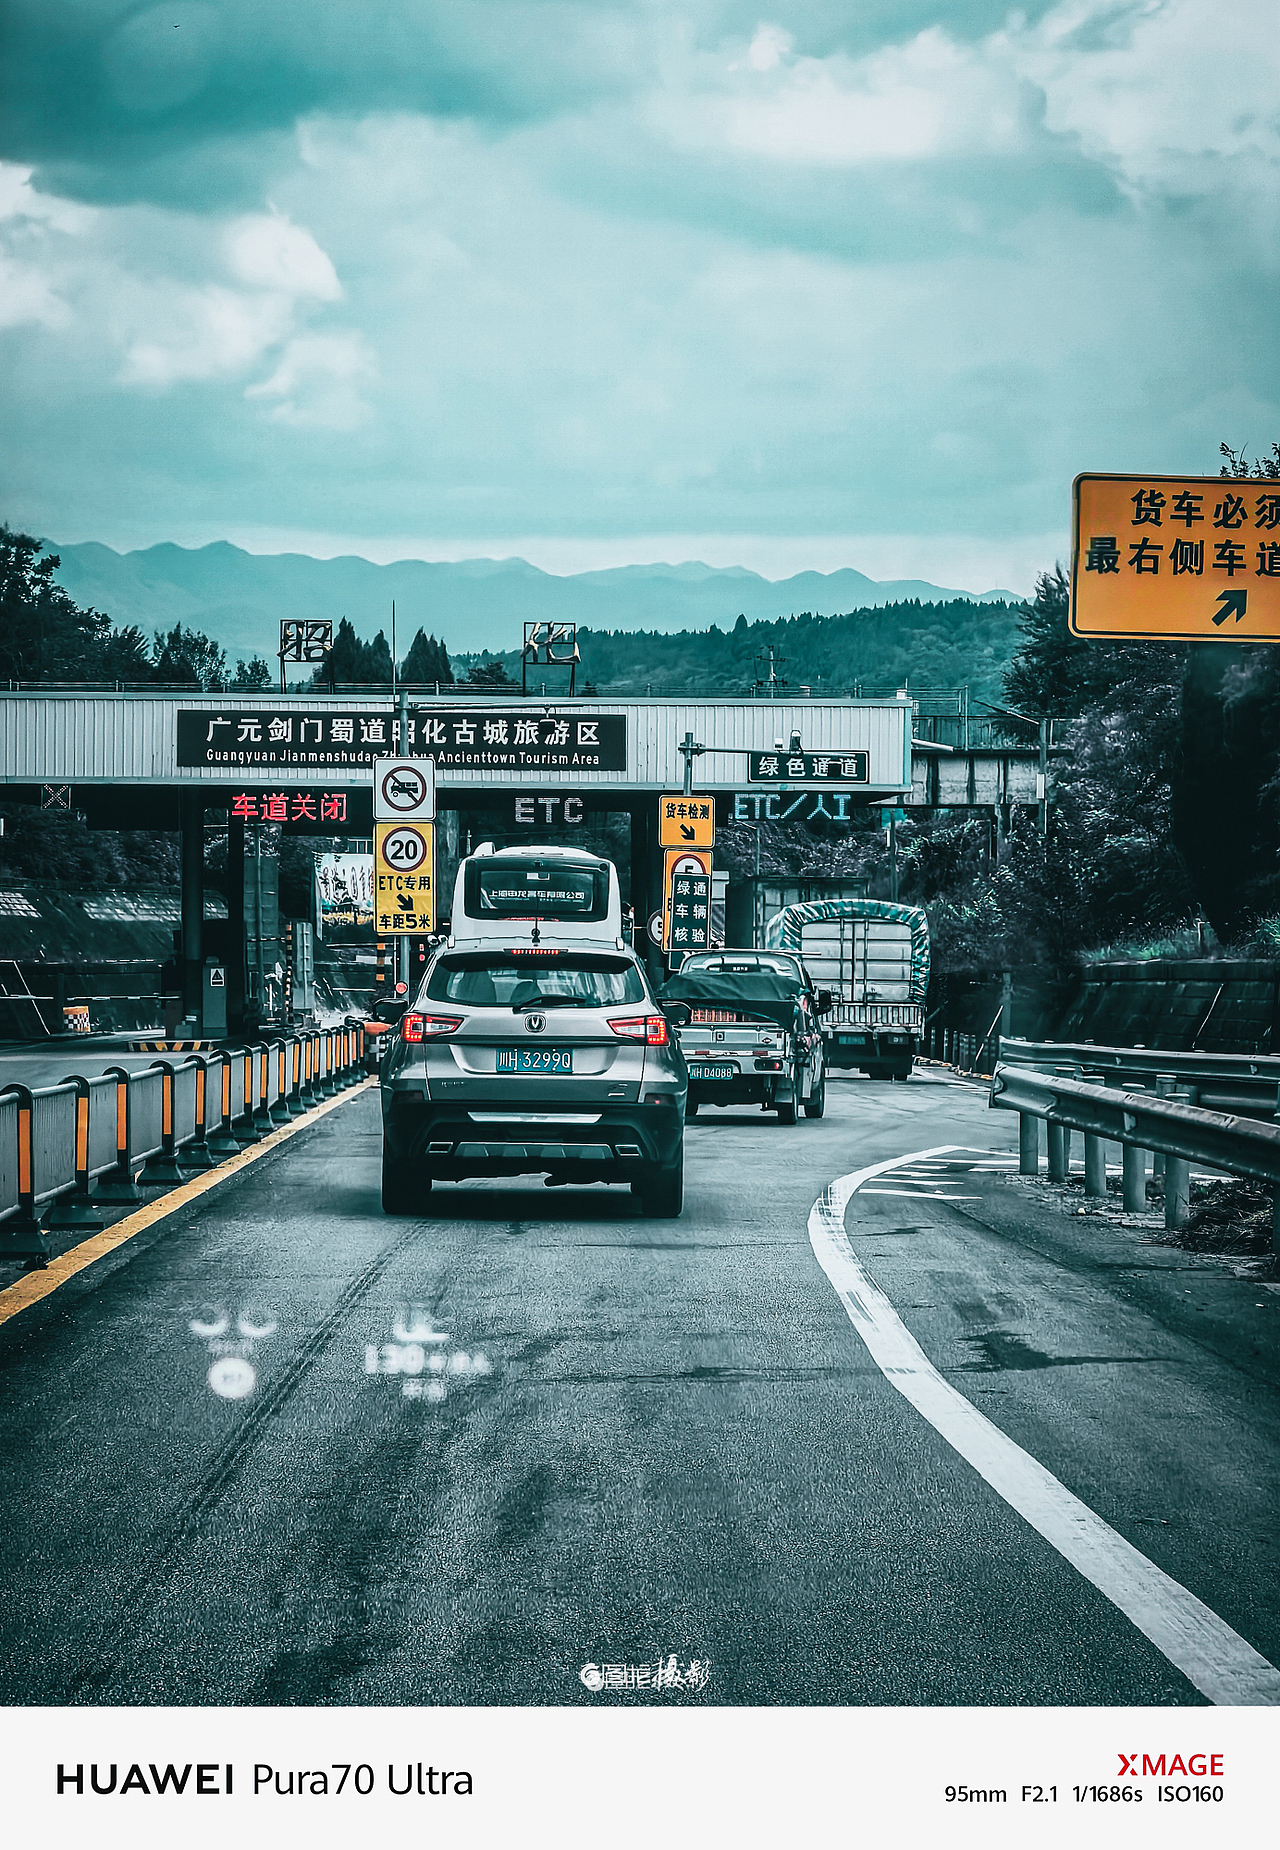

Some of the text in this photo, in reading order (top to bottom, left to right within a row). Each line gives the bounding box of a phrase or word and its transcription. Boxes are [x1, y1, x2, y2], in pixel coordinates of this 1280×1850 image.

[1130, 488, 1280, 530] 货车必须
[1085, 536, 1280, 577] 最右侧车道
[206, 716, 600, 746] 广元剑门蜀道昭化古城旅游区
[206, 748, 276, 764] Guangyuan
[438, 750, 516, 764] Ancienttown
[519, 751, 568, 765] Tourism
[572, 752, 600, 765] Area
[759, 756, 858, 777] 绿色通道
[232, 792, 347, 821] 车道关闭
[515, 797, 583, 823] ETC
[665, 803, 710, 820] 货车检测
[390, 839, 418, 860] 20
[378, 875, 431, 891] ETC专用
[676, 880, 707, 897] 绿通
[675, 903, 707, 920] 车辆
[378, 913, 431, 930] 车距5米
[674, 926, 706, 943] 核验
